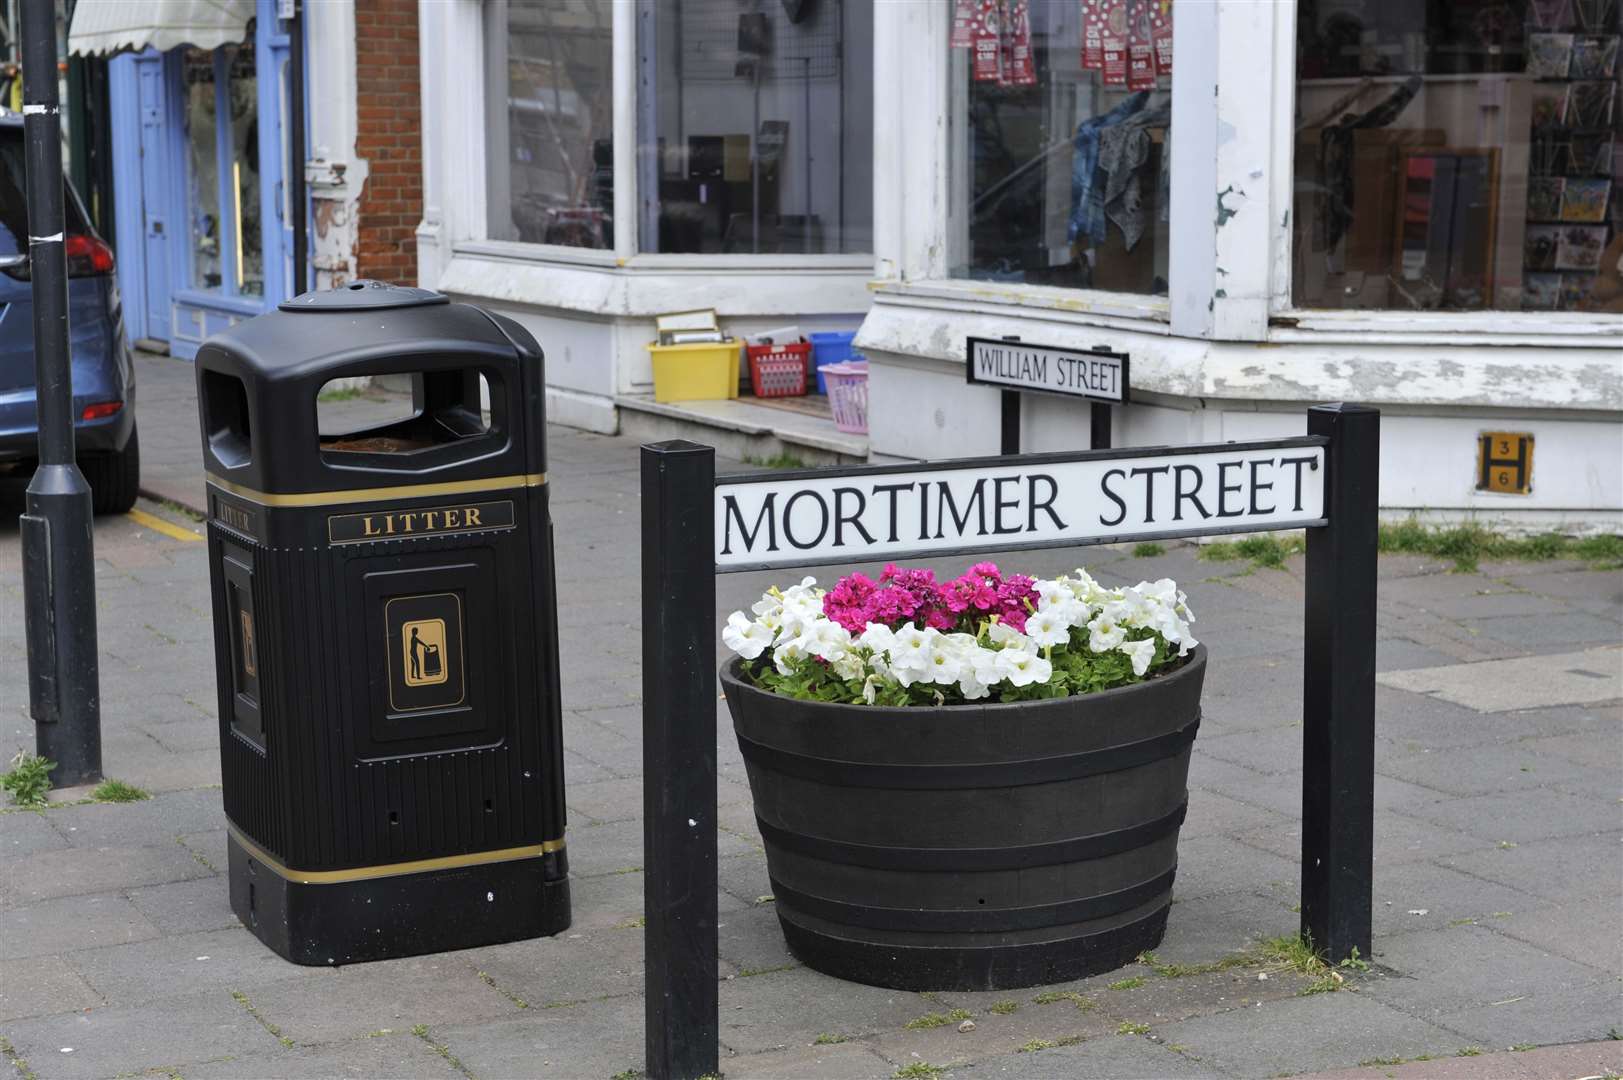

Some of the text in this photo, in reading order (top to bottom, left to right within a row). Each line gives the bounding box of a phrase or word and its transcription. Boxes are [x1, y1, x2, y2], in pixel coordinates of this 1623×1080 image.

[979, 347, 1120, 393] WILLIAM STREET
[1499, 440, 1510, 456] 3
[1498, 471, 1510, 486] 6
[720, 456, 1318, 556] MORTIMER STREET
[362, 507, 483, 537] LITTER
